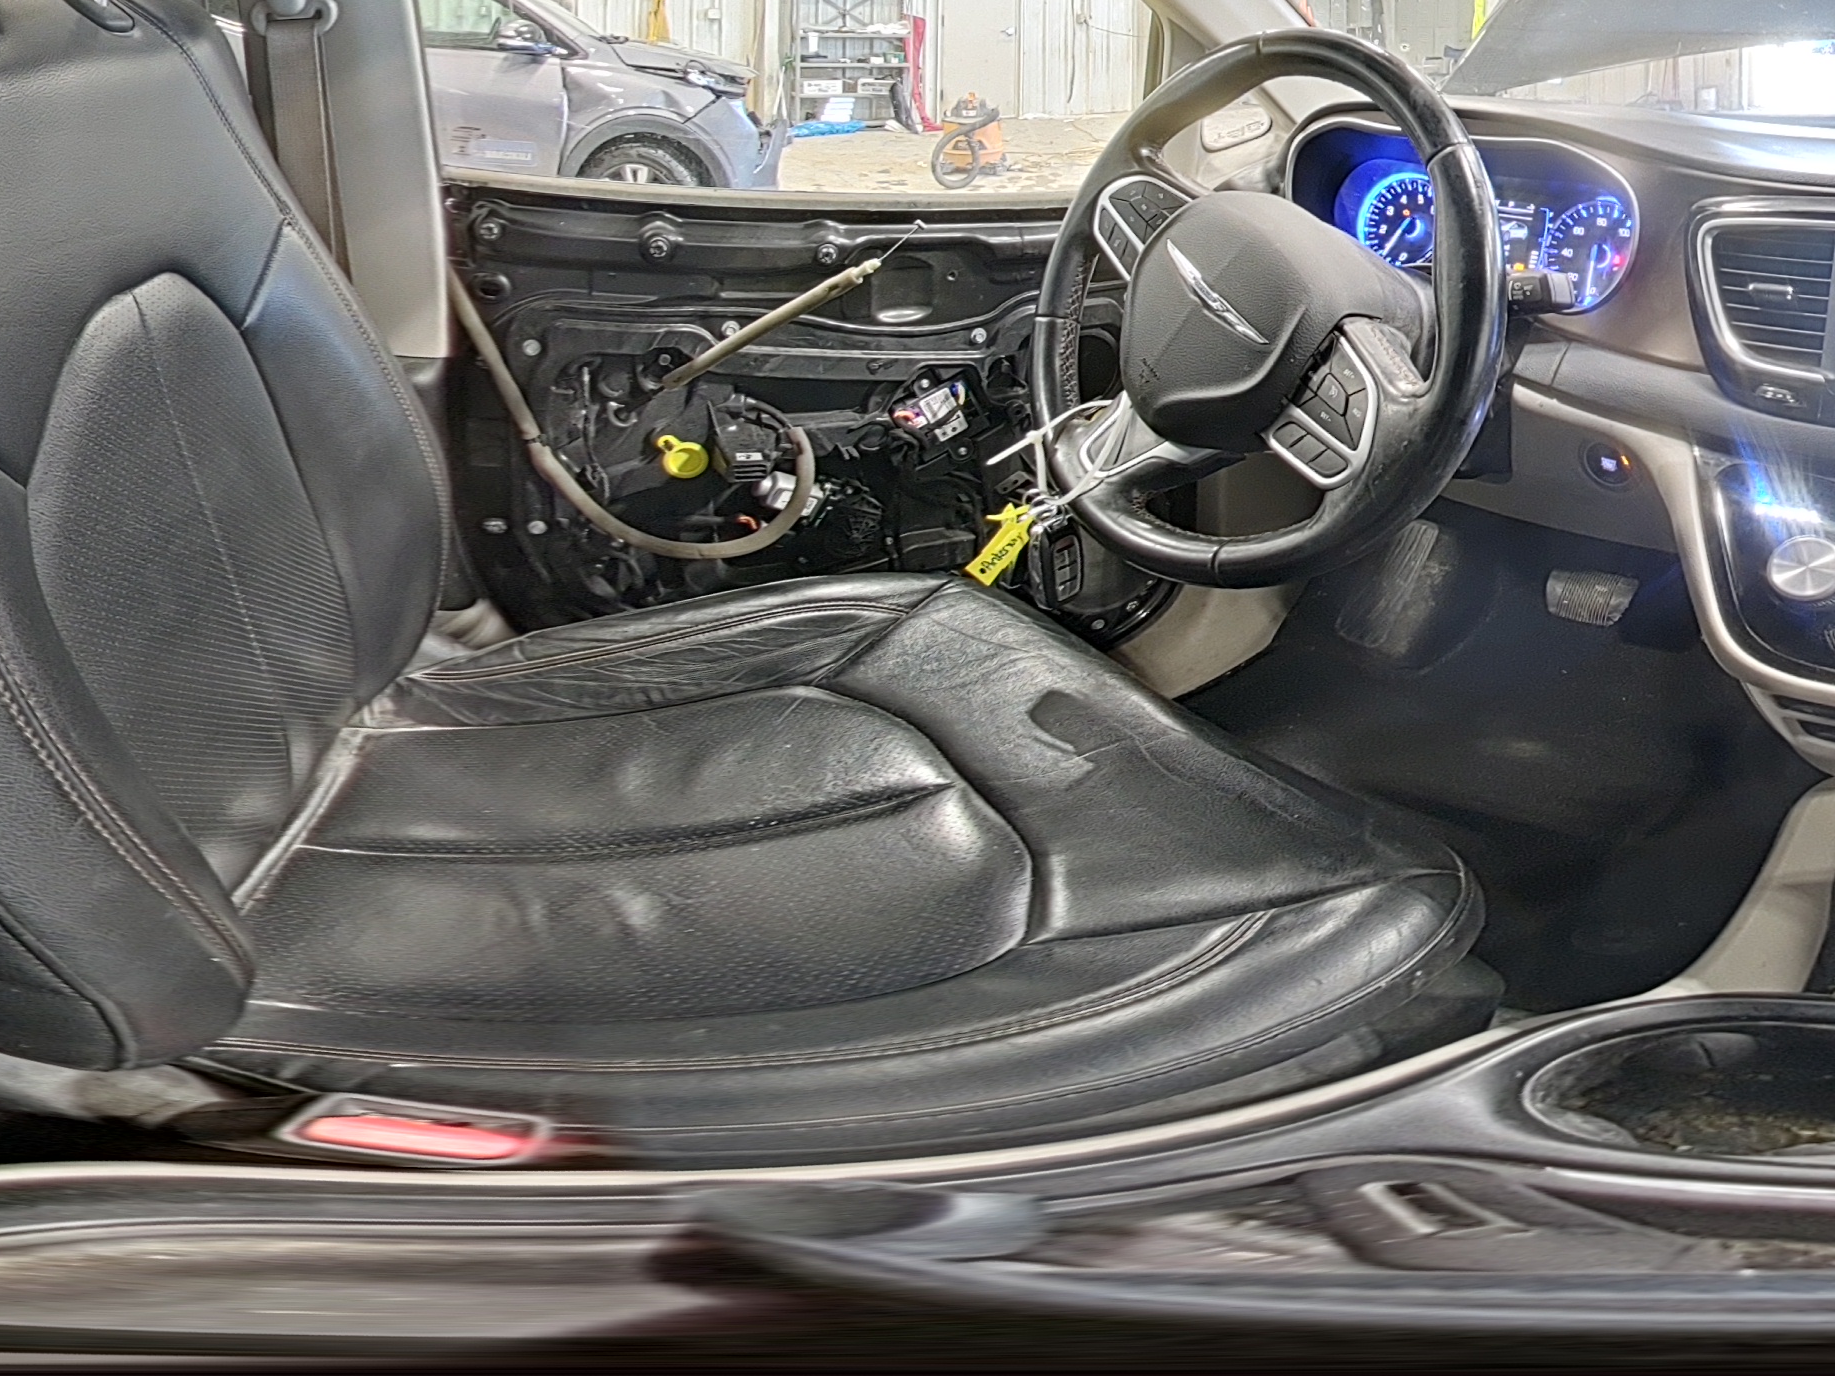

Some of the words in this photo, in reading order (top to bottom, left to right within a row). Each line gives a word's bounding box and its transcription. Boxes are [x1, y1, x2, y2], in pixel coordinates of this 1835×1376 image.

[1400, 195, 1407, 204] 4
[1417, 194, 1424, 204] 5
[1386, 206, 1394, 216] 3
[1596, 217, 1607, 227] 80
[1379, 224, 1387, 234] 2
[1573, 226, 1584, 235] 60
[1618, 228, 1631, 237] 100
[1399, 252, 1408, 261] 0
[1561, 248, 1573, 258] 40
